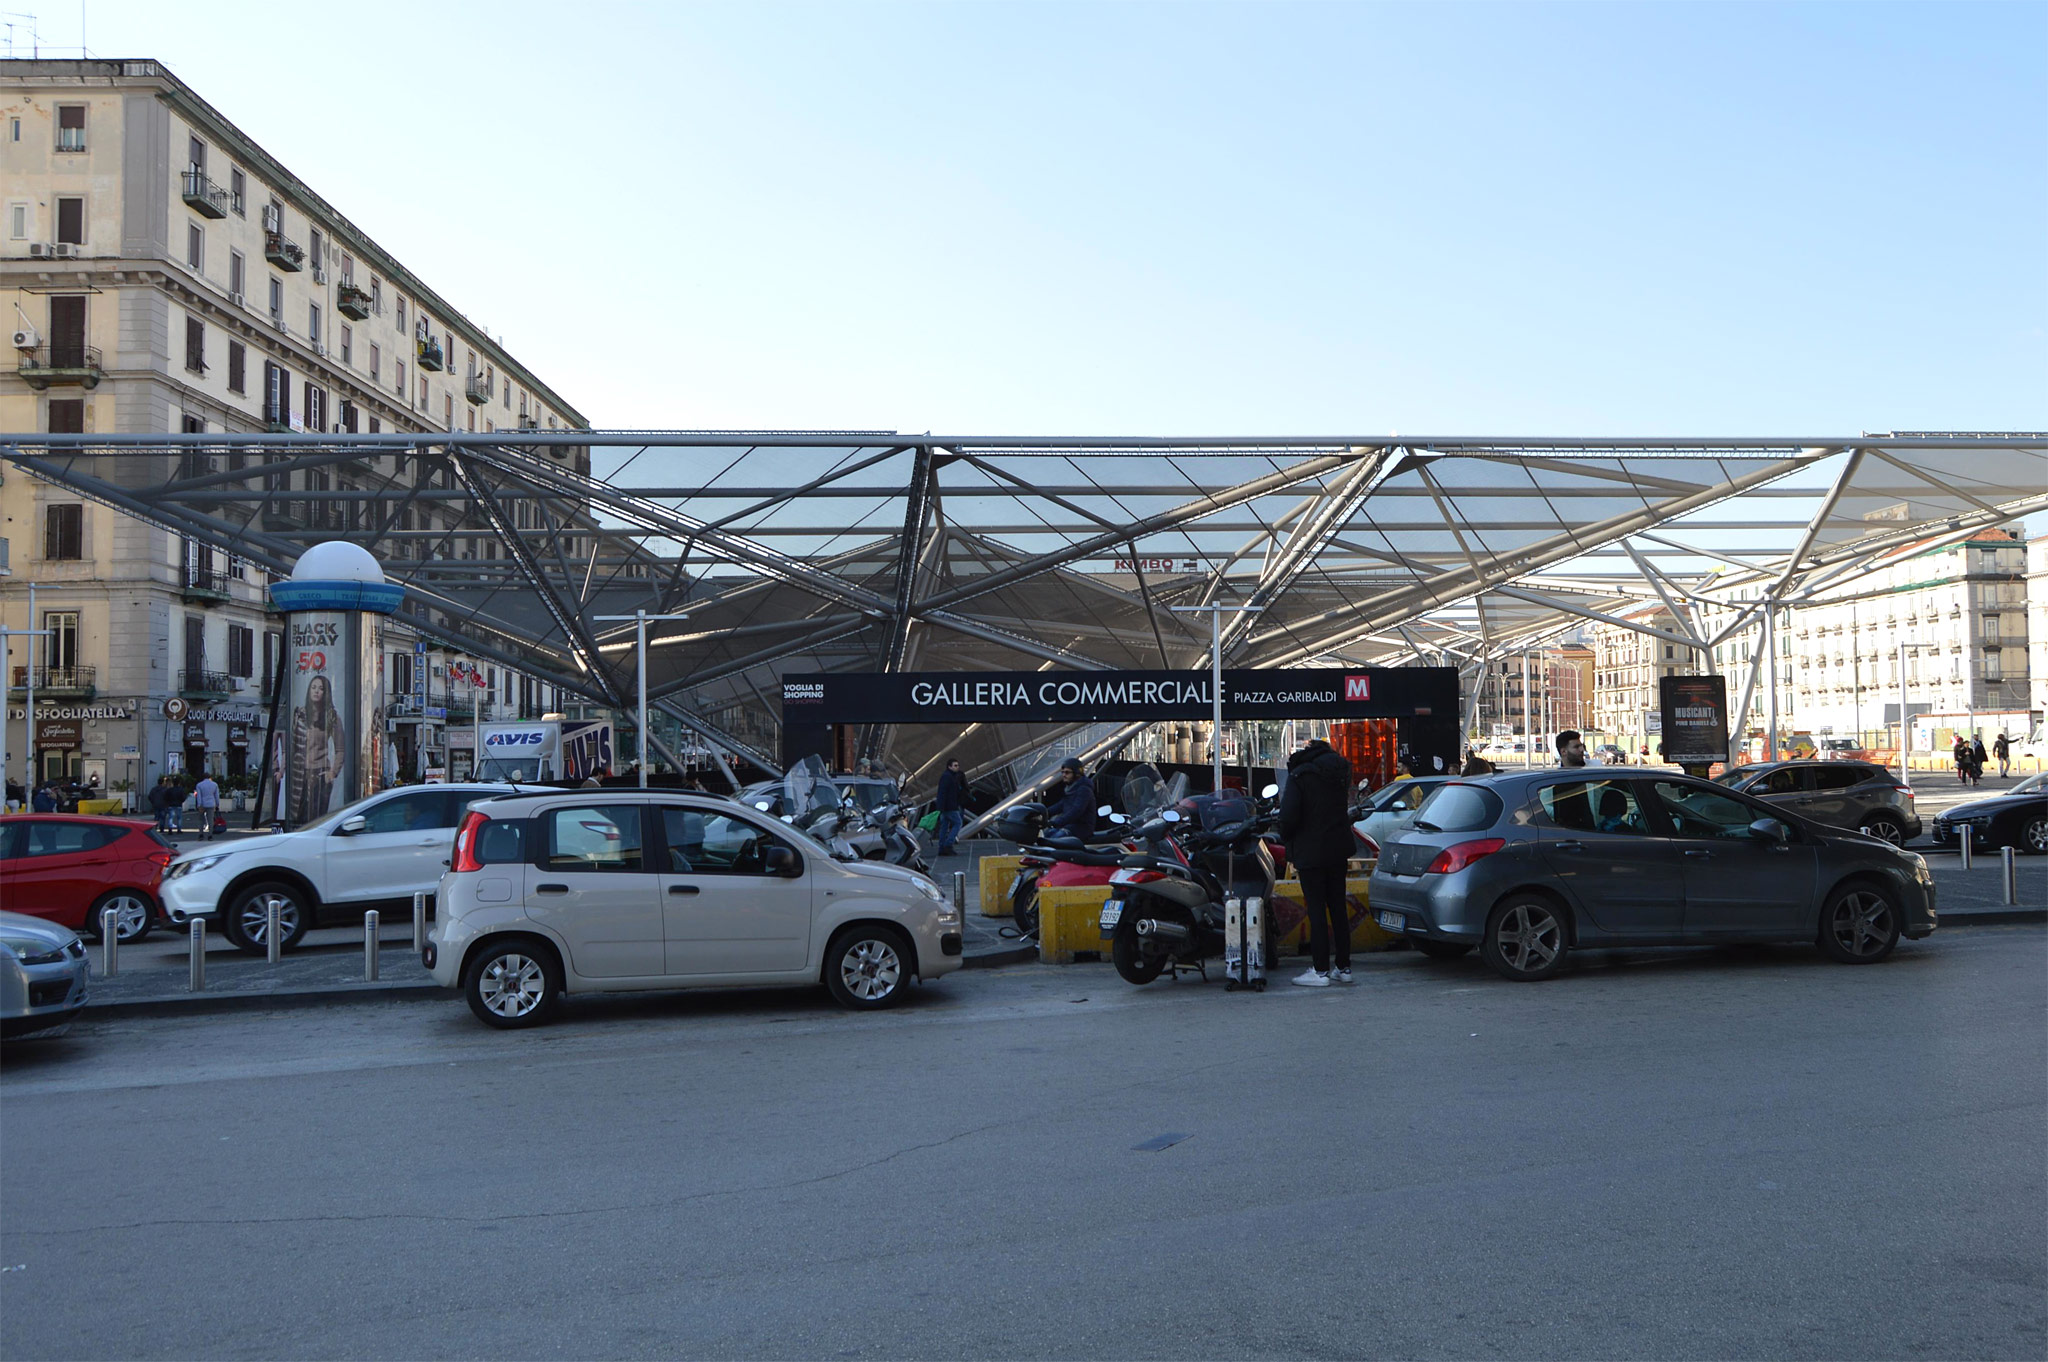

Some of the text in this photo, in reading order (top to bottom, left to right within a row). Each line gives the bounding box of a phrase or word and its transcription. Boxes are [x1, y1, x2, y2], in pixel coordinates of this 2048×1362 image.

[293, 623, 337, 636] BLACK
[292, 635, 339, 647] FRIDAY
[911, 680, 1337, 705] GALLERIA COMMERCIALE PIAZZA GARIBALDI
[1347, 679, 1369, 697] M
[784, 691, 824, 699] SHOPPING
[35, 708, 126, 719] SFOGLIATELLA
[188, 710, 254, 722] CUORI DI SFOGLIATELLA
[486, 732, 544, 746] AVIS
